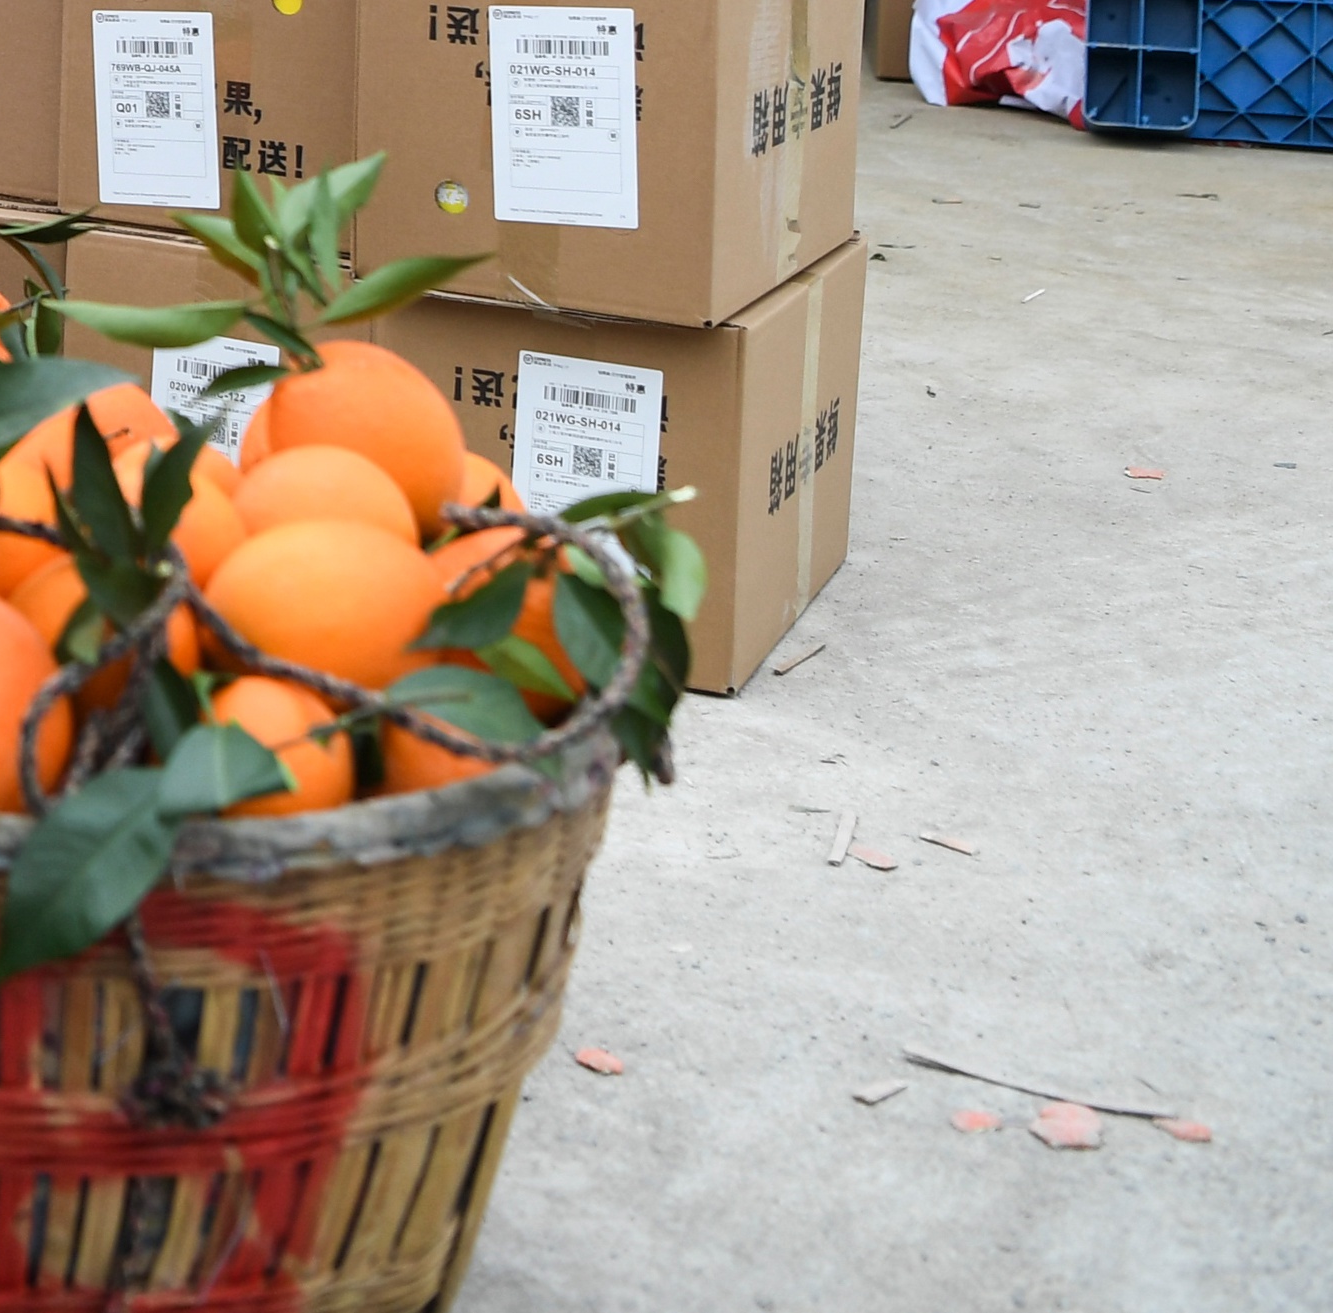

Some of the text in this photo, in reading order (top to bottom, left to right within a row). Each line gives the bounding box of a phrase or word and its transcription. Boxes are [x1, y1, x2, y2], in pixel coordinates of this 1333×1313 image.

[509, 64, 596, 78] 021WG-SH-014
[514, 108, 542, 121] 6SH
[751, 62, 842, 158] 鲜果专用箱
[535, 409, 622, 432] 021WG-SH-014
[536, 452, 564, 468] 6SH
